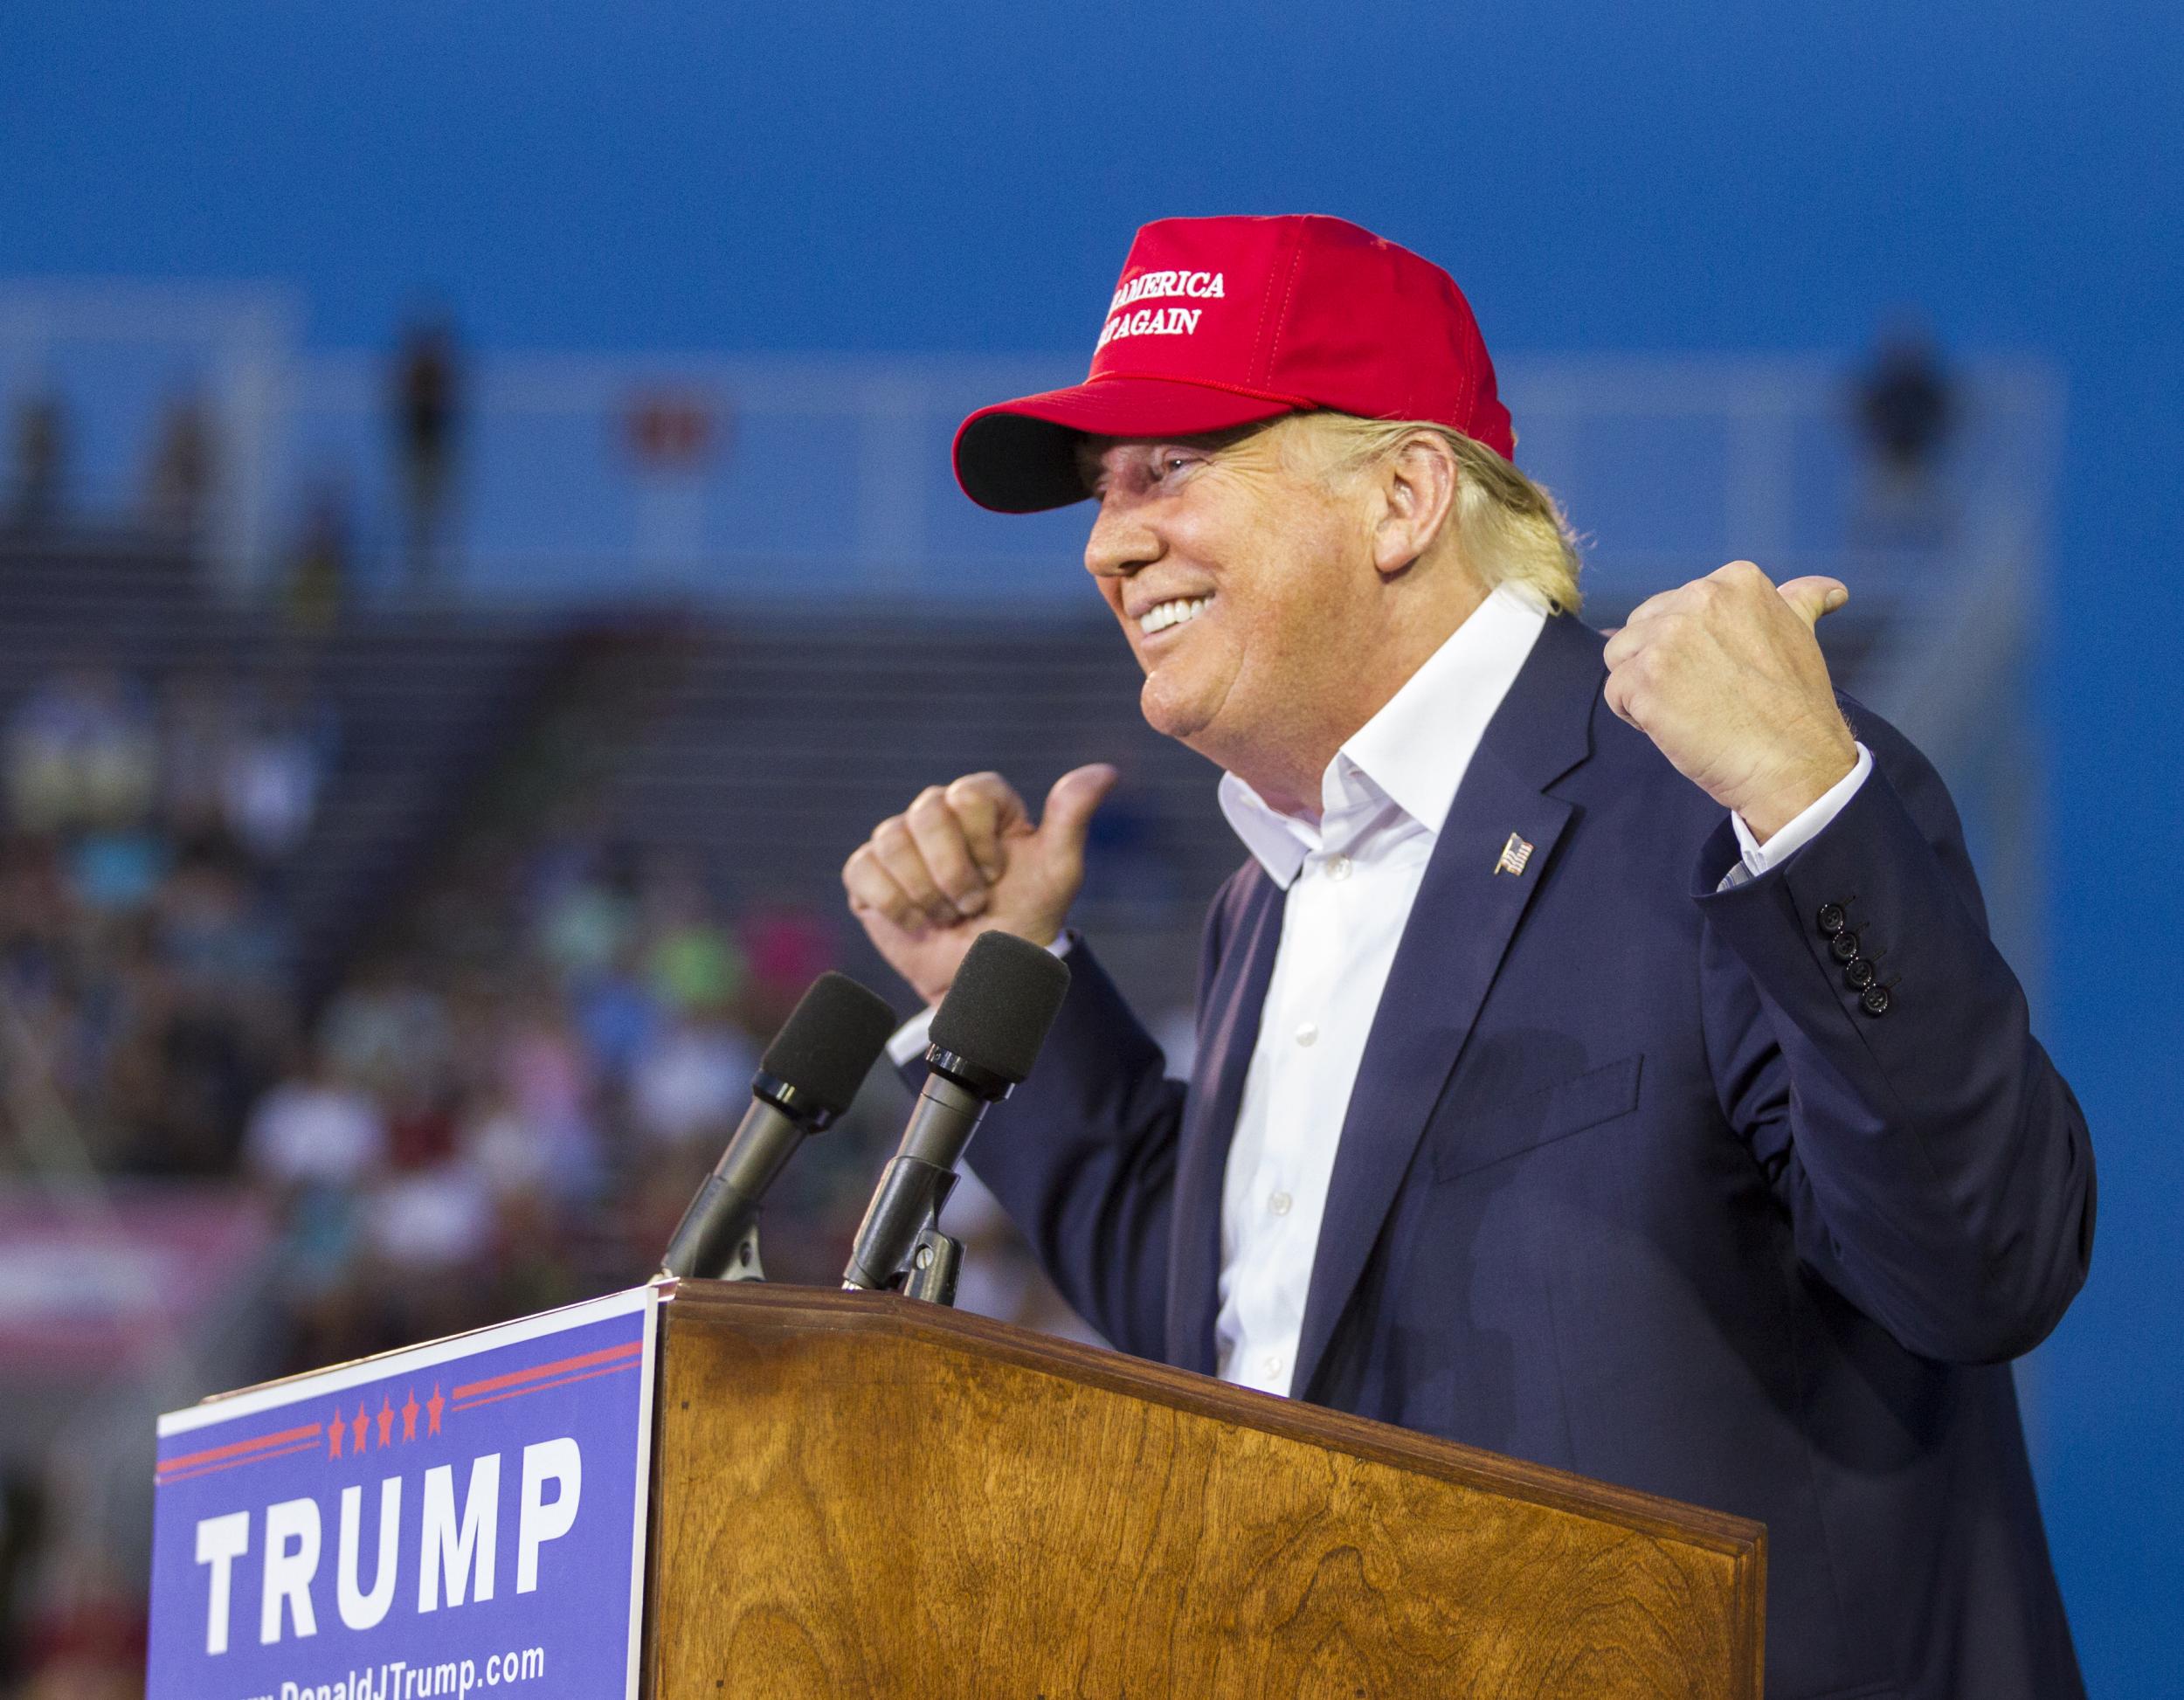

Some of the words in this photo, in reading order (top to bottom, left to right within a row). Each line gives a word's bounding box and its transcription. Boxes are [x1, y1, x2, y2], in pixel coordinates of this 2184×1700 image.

[1116, 271, 1225, 308] AMERICA
[1113, 308, 1202, 340] AGAIN
[196, 1437, 582, 1655] TRUMP
